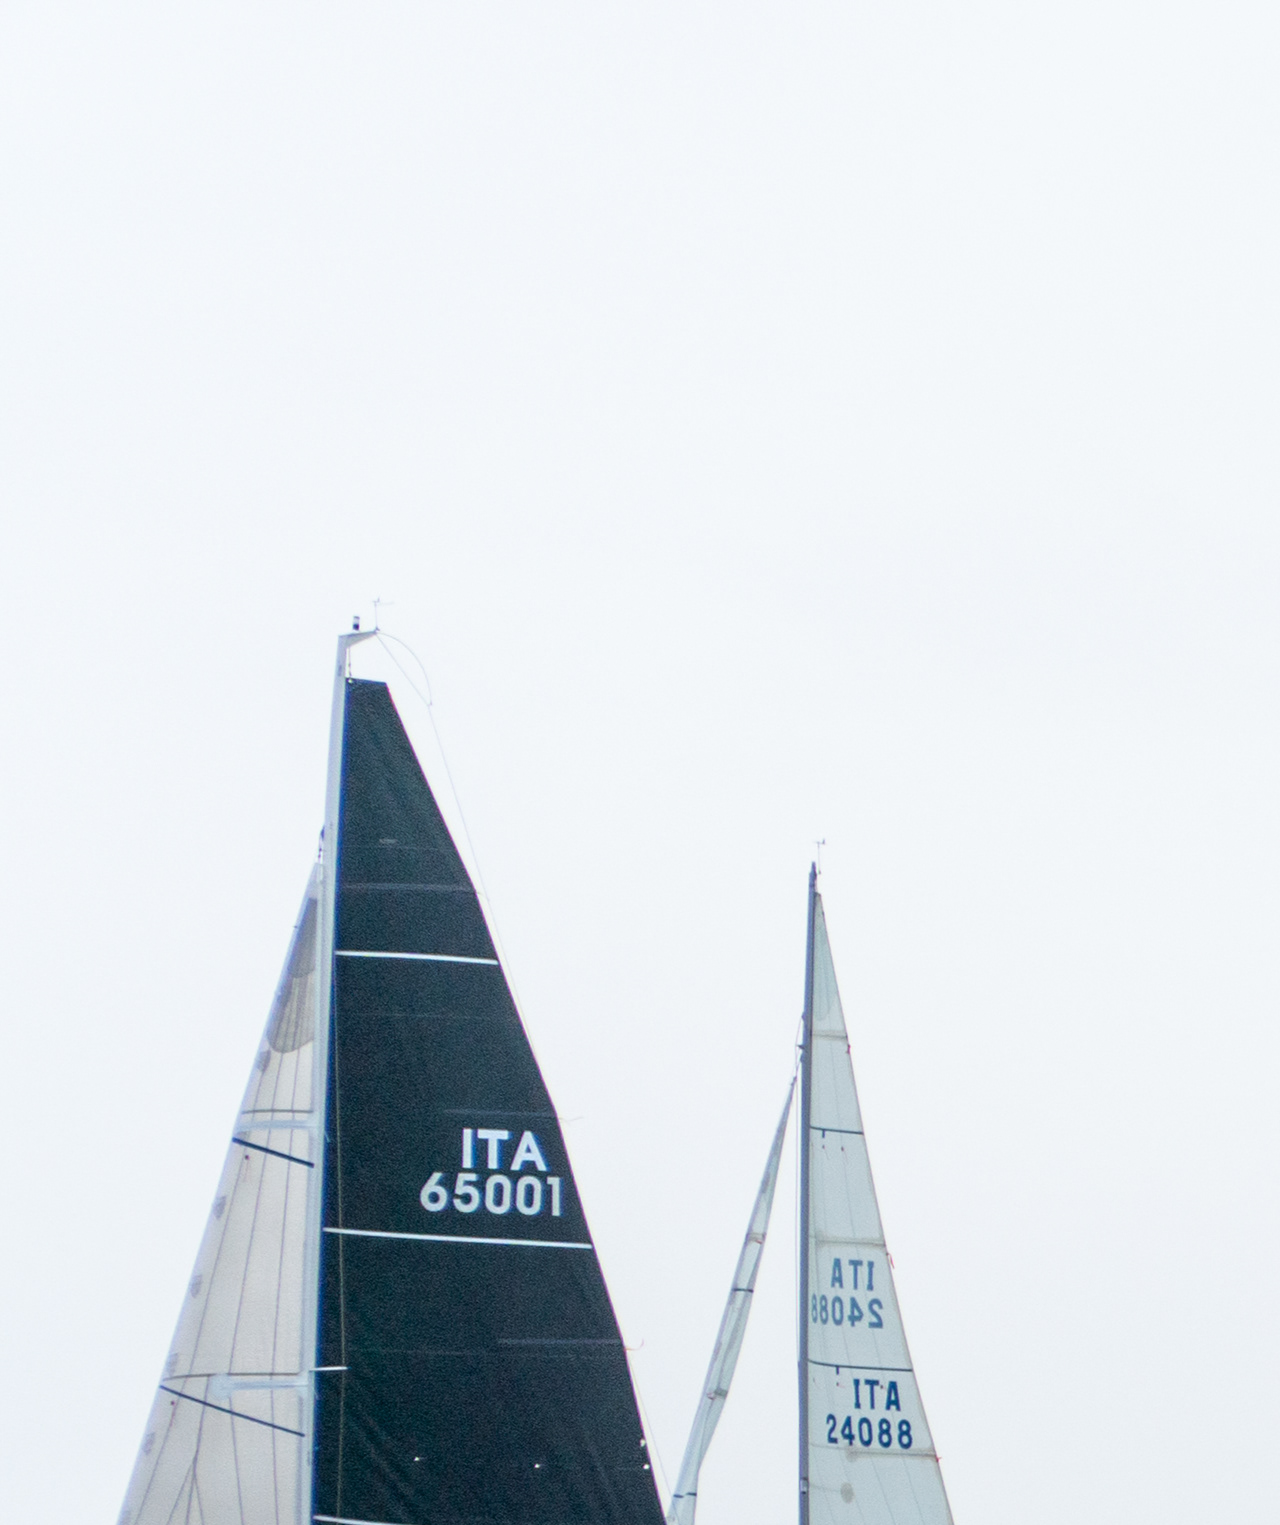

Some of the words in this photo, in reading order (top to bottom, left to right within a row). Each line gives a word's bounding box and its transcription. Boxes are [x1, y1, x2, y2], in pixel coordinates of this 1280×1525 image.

[461, 1128, 549, 1171] ITA
[419, 1171, 562, 1217] 65001
[853, 1377, 902, 1412] ITA
[826, 1413, 913, 1450] 24088
